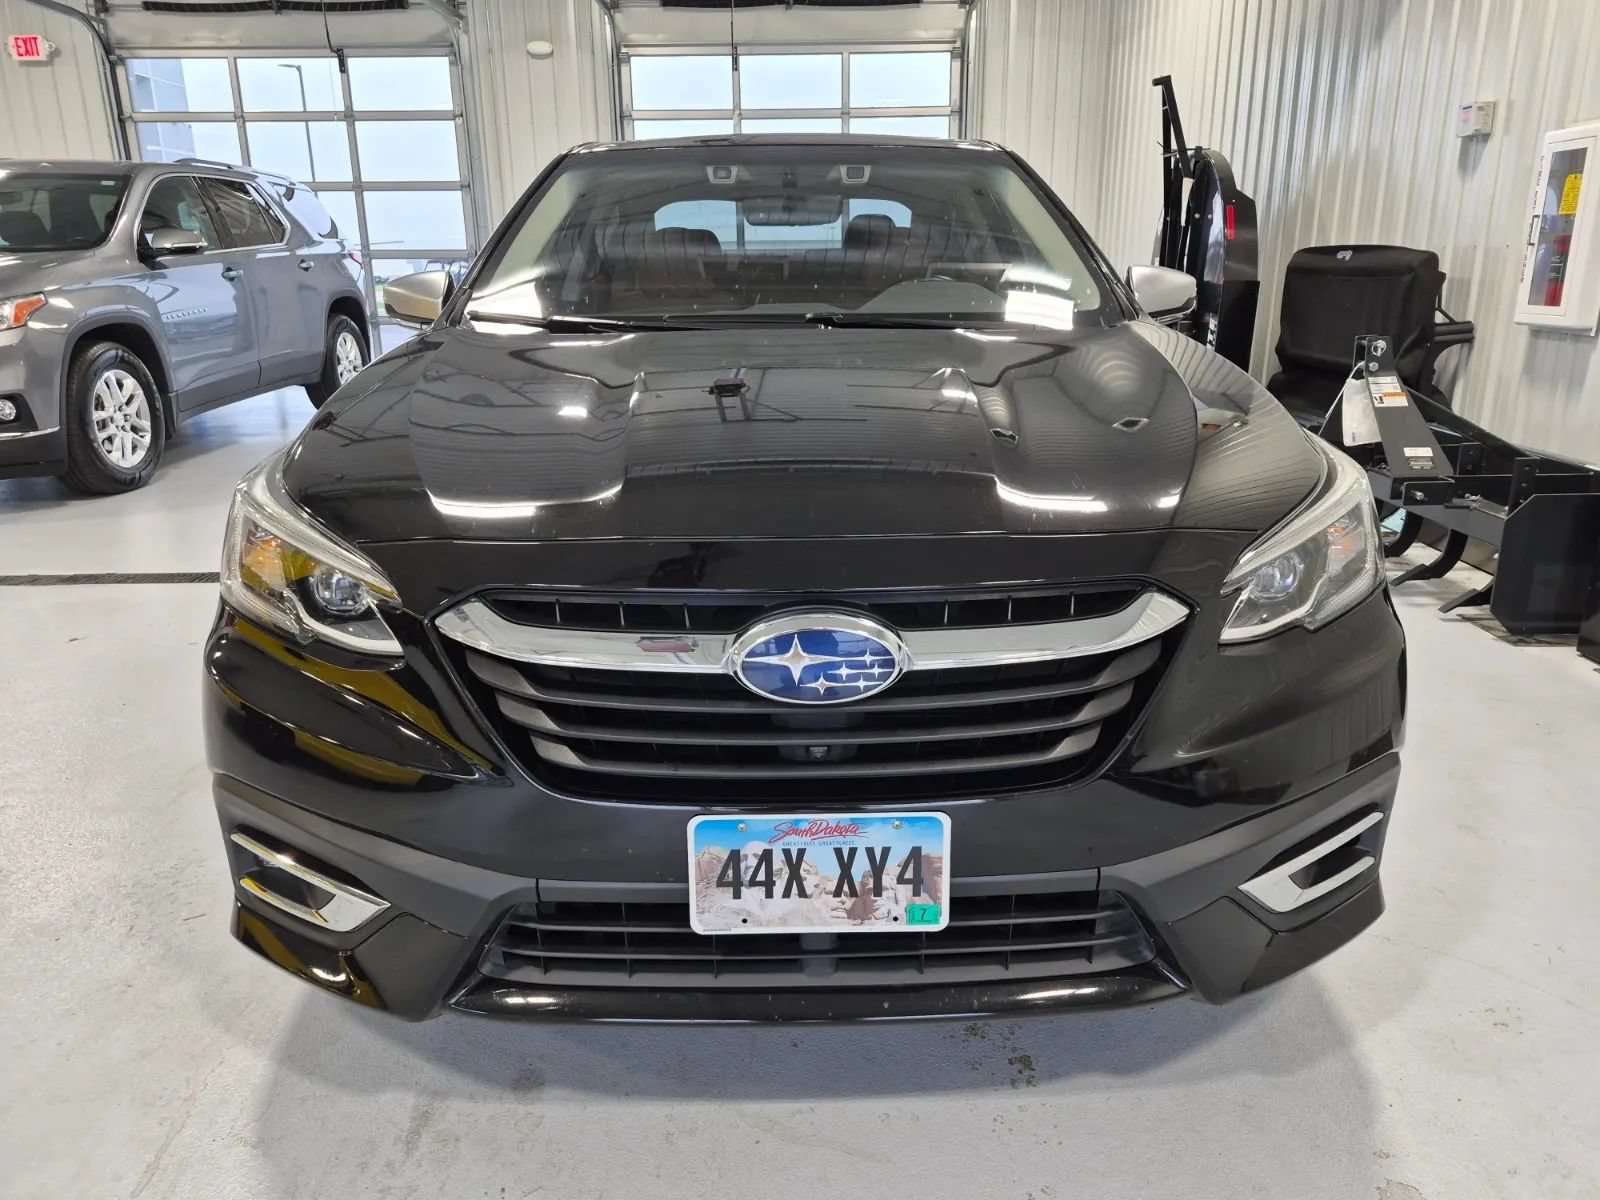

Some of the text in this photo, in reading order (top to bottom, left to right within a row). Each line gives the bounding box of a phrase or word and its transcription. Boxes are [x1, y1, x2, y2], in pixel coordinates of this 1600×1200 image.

[14, 36, 40, 57] EXIT
[768, 819, 863, 844] South Dakota
[716, 846, 923, 900] 44X XY4
[920, 906, 928, 921] 7
